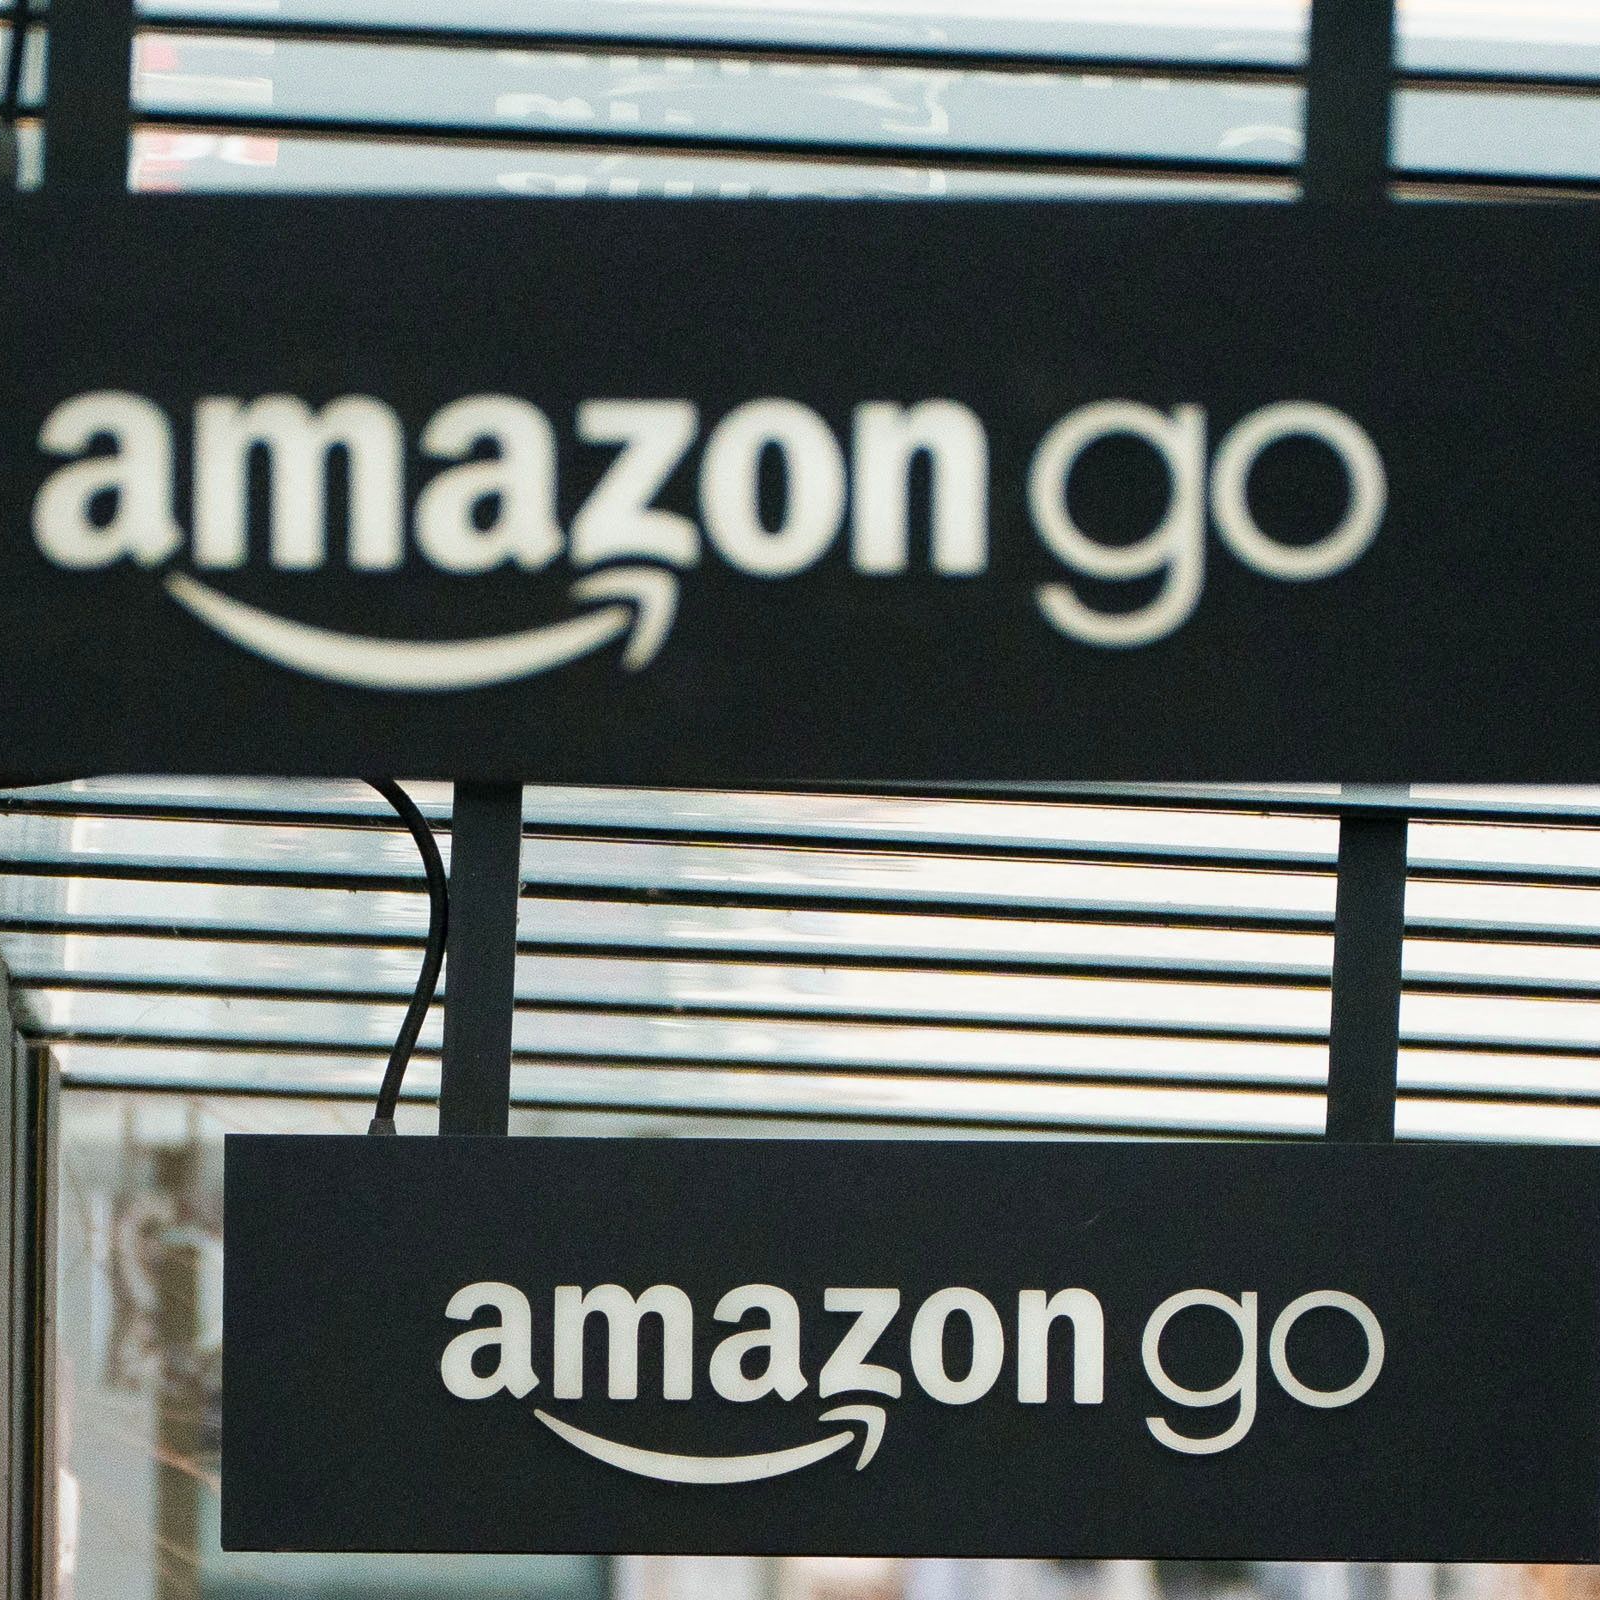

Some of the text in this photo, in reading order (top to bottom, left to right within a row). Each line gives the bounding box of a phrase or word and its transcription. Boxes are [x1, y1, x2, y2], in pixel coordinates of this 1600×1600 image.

[33, 391, 1386, 646] amazon go
[439, 1280, 1386, 1456] amazon go
